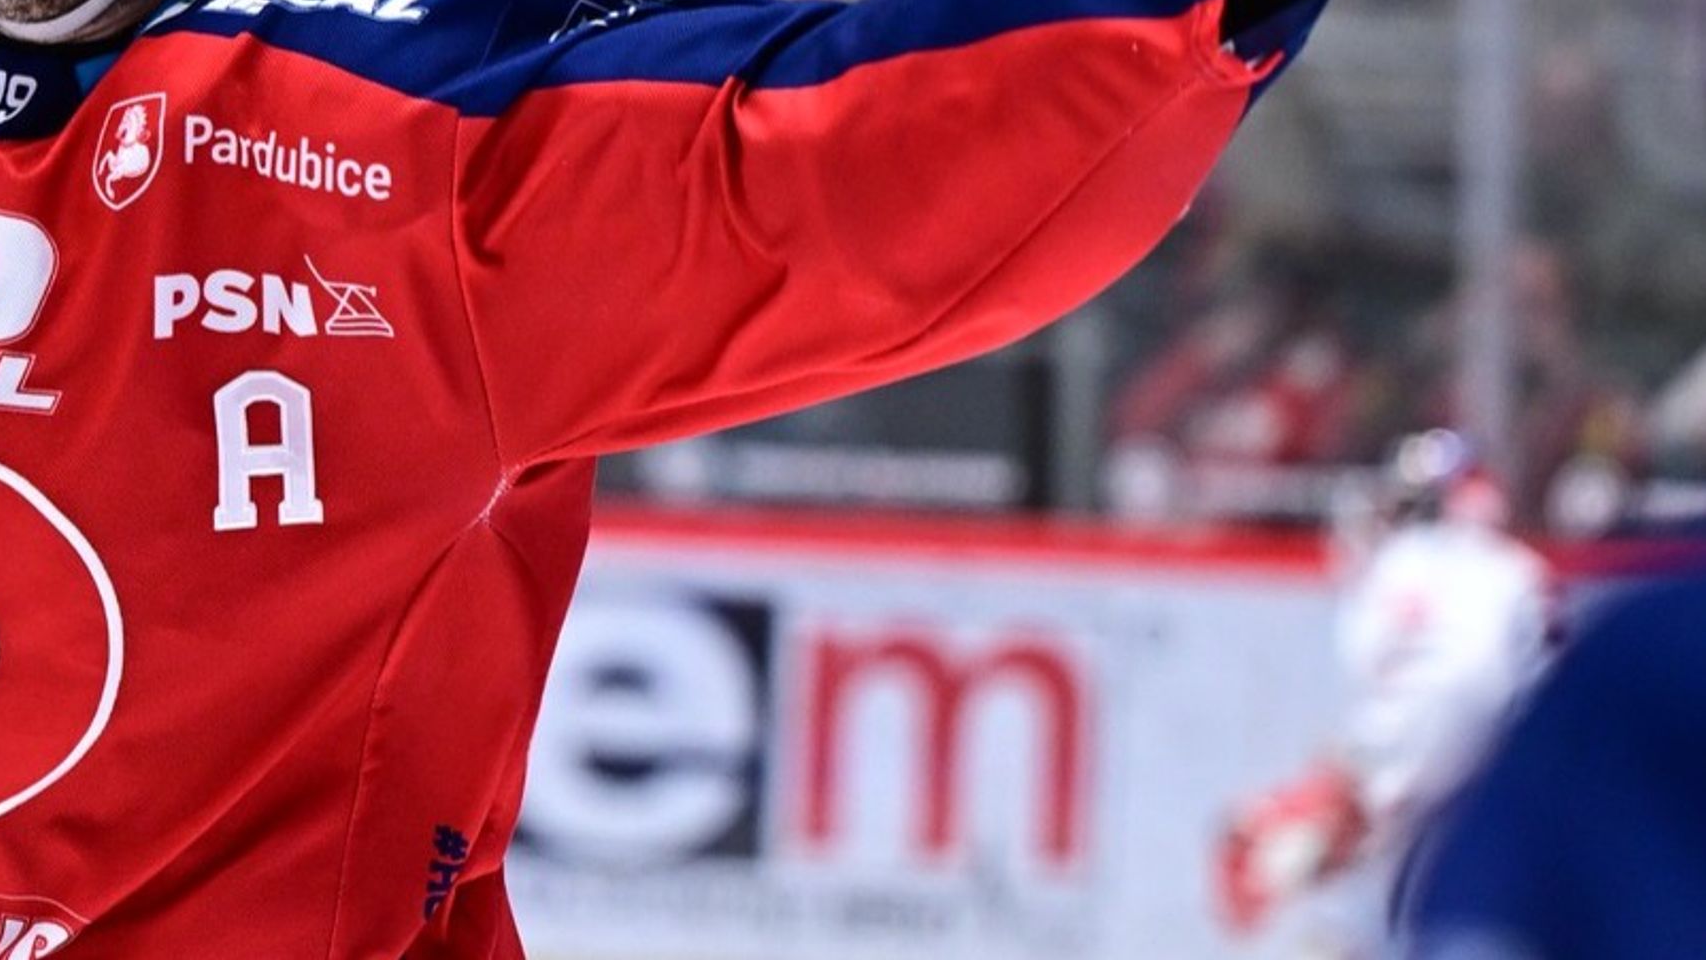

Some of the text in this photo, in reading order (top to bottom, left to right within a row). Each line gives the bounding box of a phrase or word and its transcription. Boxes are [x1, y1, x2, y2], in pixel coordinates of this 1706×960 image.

[183, 114, 393, 201] Pardubice
[153, 269, 318, 339] PSN
[213, 369, 324, 532] A
